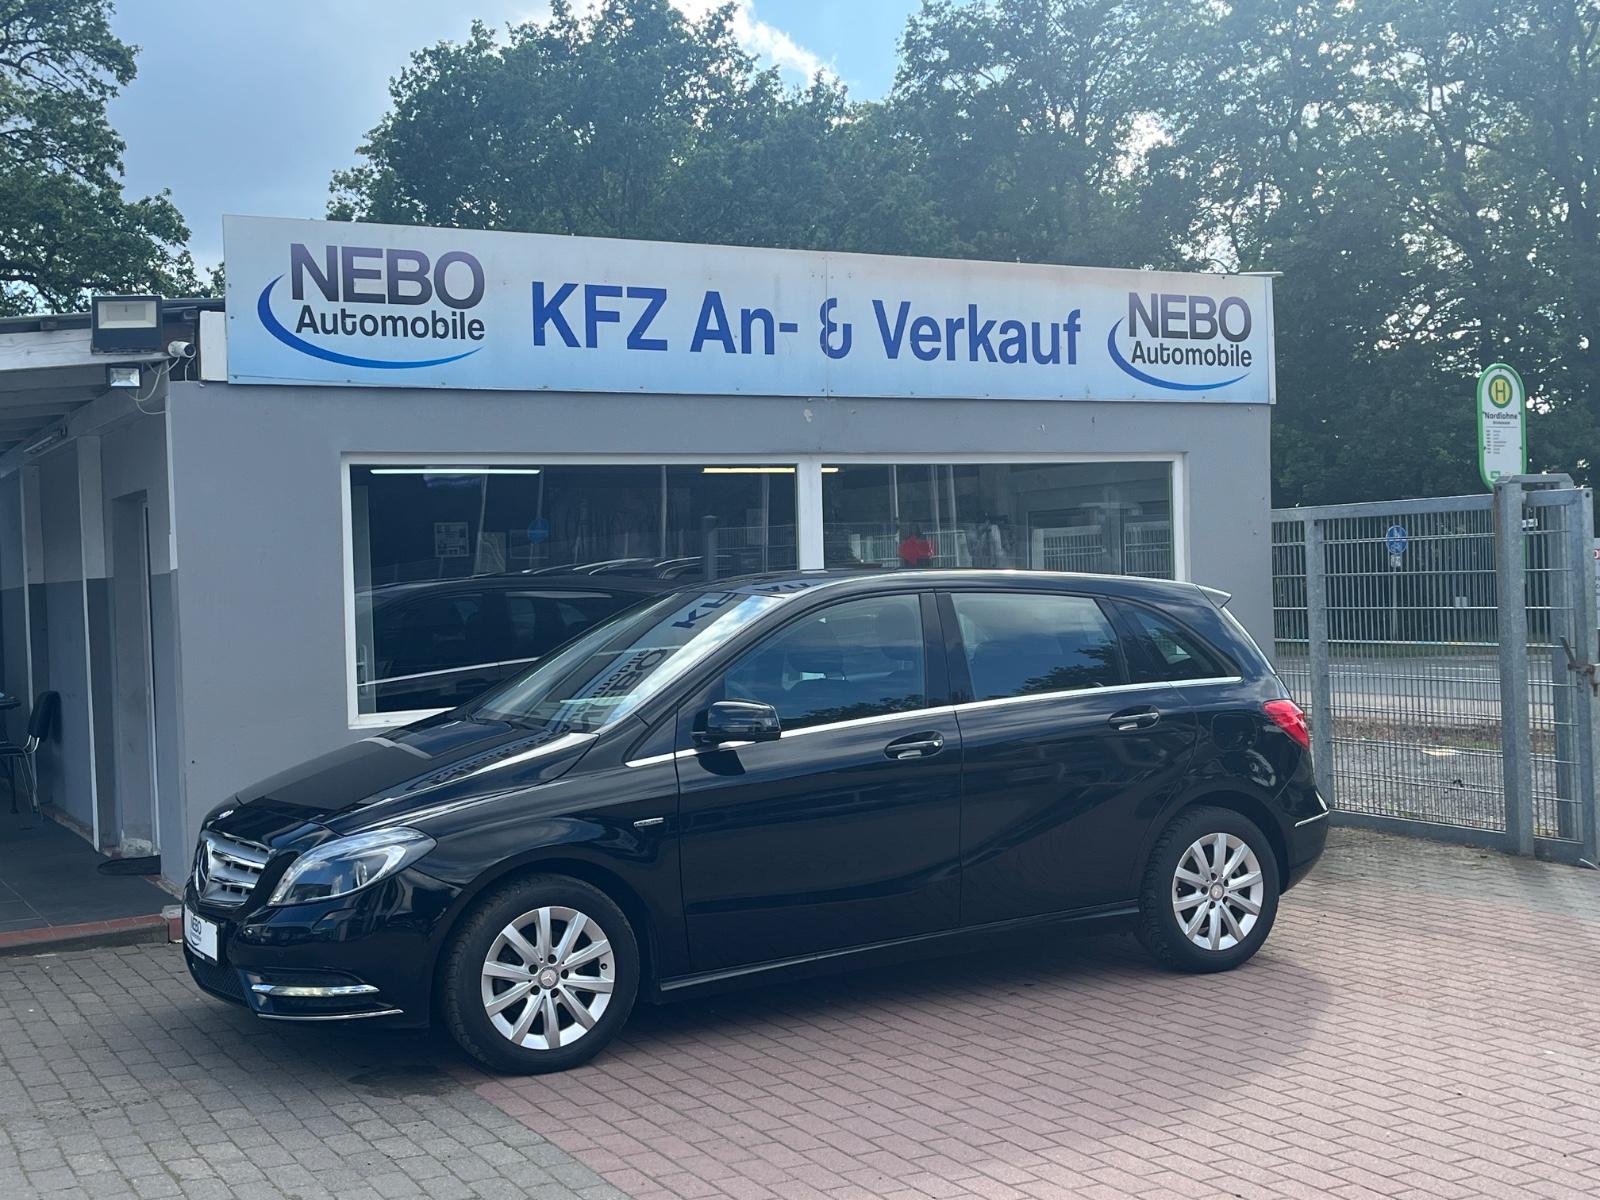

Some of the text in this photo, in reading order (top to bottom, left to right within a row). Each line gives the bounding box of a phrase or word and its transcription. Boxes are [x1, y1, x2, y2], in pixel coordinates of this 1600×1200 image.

[290, 243, 485, 310] NEBO
[295, 304, 486, 341] Automobile
[531, 280, 1082, 366] KFZ An- & Verkauf
[1128, 292, 1252, 343] NEBO
[1130, 340, 1253, 368] Automobile
